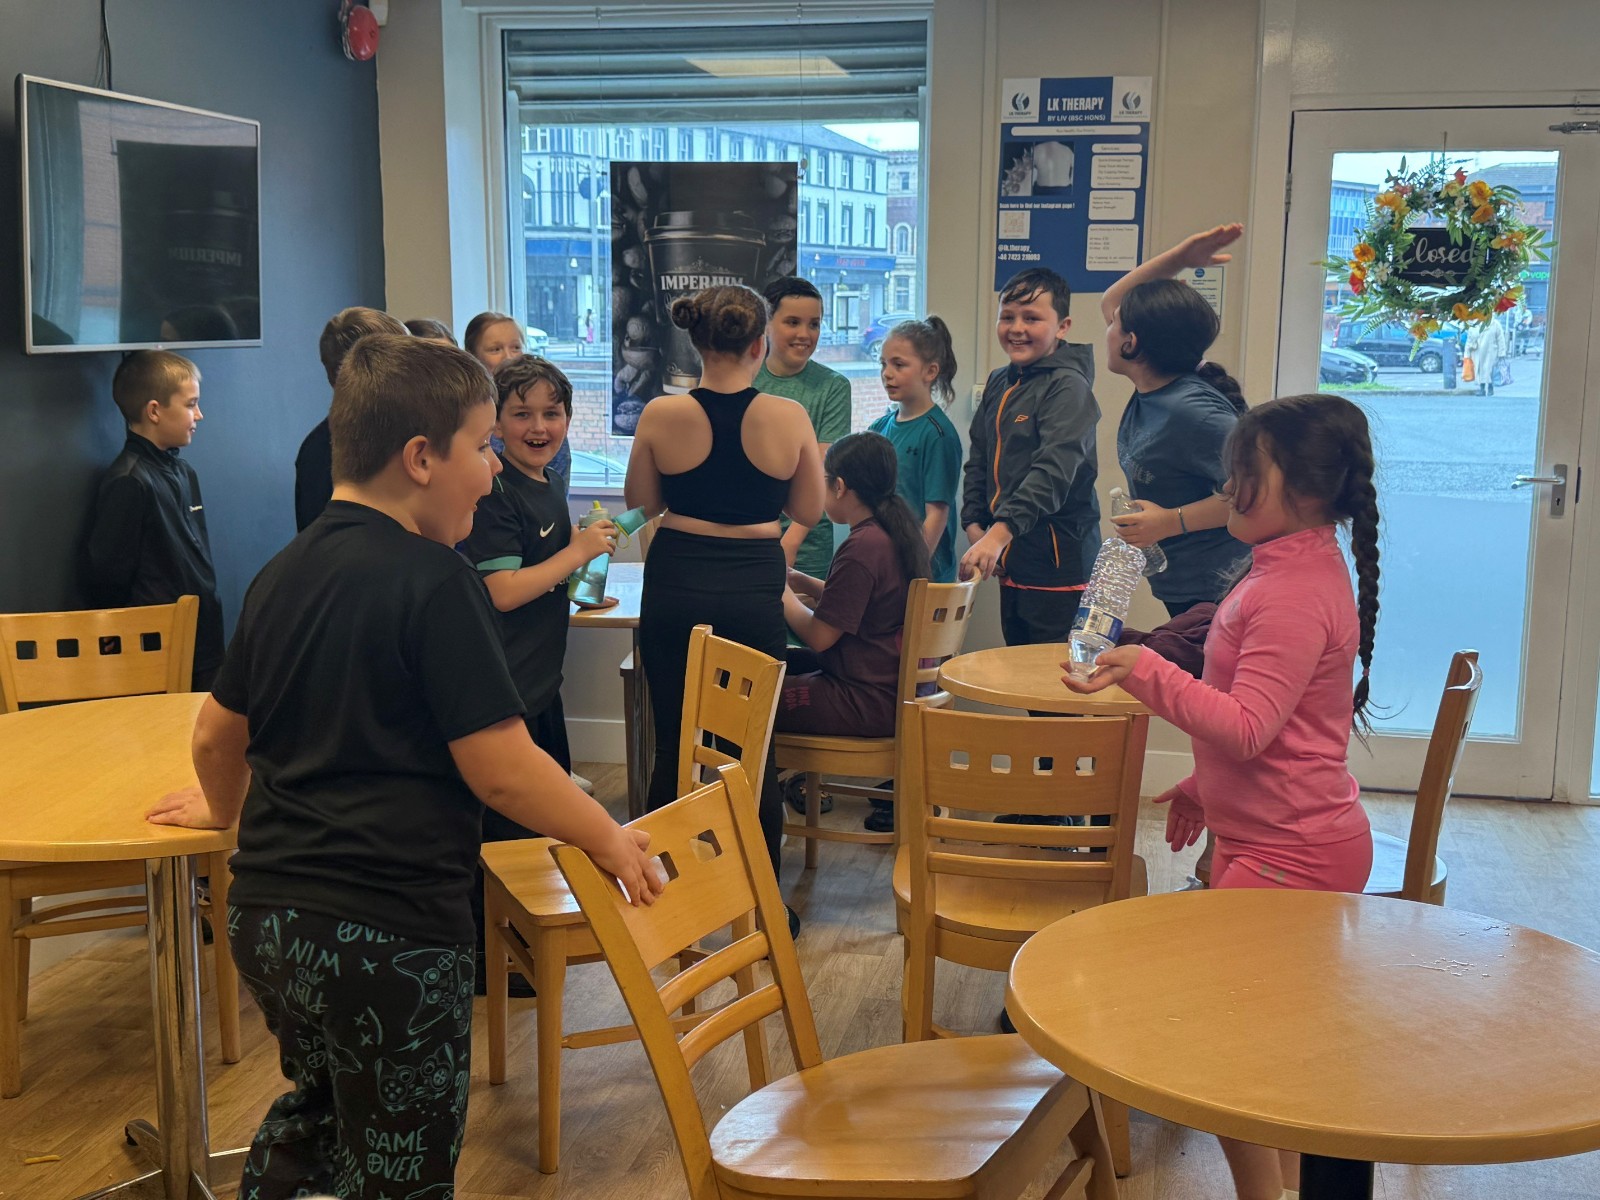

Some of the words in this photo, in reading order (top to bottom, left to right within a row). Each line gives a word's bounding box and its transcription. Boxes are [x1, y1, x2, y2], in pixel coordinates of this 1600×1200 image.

[1047, 98, 1060, 111] LK
[1061, 97, 1105, 111] THERAPY
[1405, 236, 1475, 264] losed
[365, 1123, 429, 1152] GAME
[366, 1152, 425, 1182] OVER
